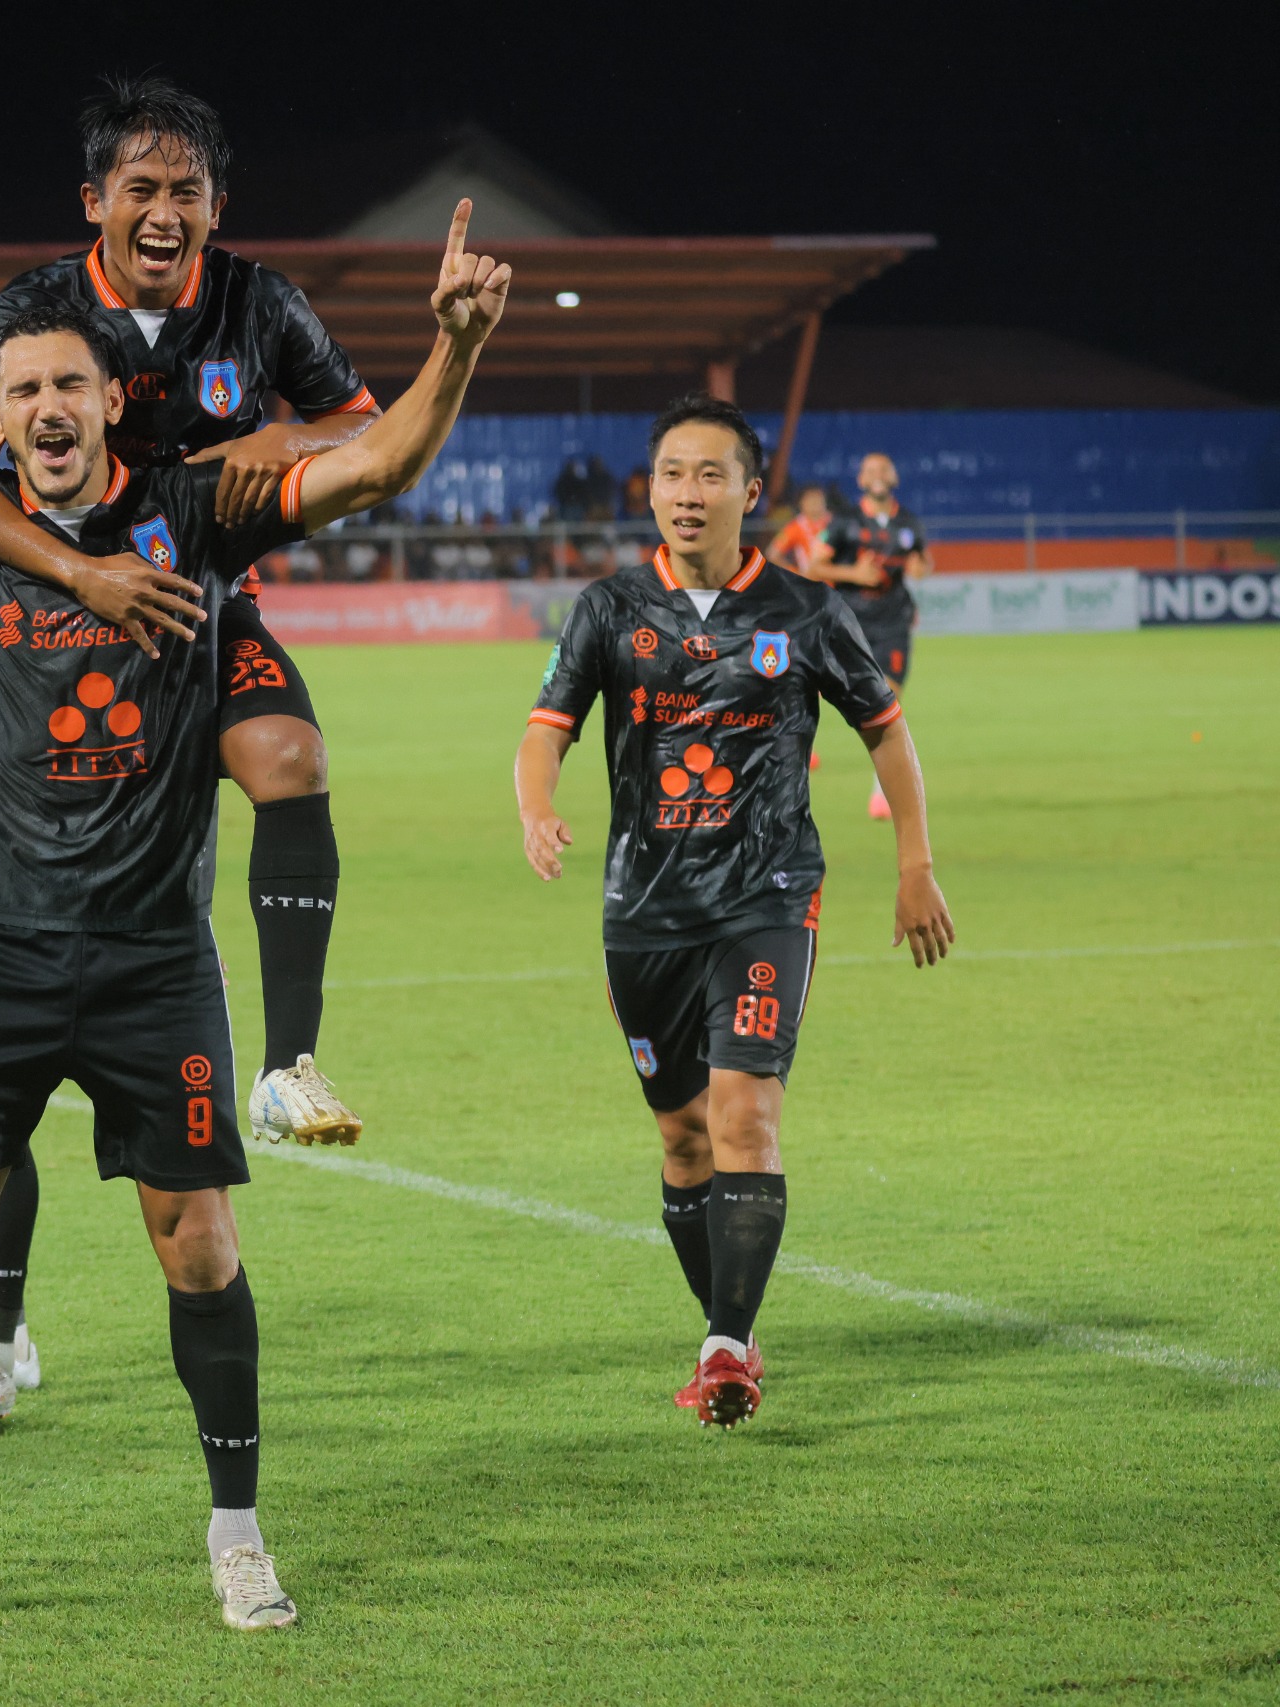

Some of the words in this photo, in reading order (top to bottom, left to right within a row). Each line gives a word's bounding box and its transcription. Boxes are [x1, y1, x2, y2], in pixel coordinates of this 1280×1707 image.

[229, 658, 287, 696] 23
[654, 692, 701, 709] BANK
[658, 805, 732, 823] TITAN
[260, 895, 333, 912] XTEN
[734, 994, 780, 1041] 89
[184, 1084, 212, 1092] XTEN
[187, 1096, 212, 1147] 9
[201, 1431, 258, 1448] XTEN
